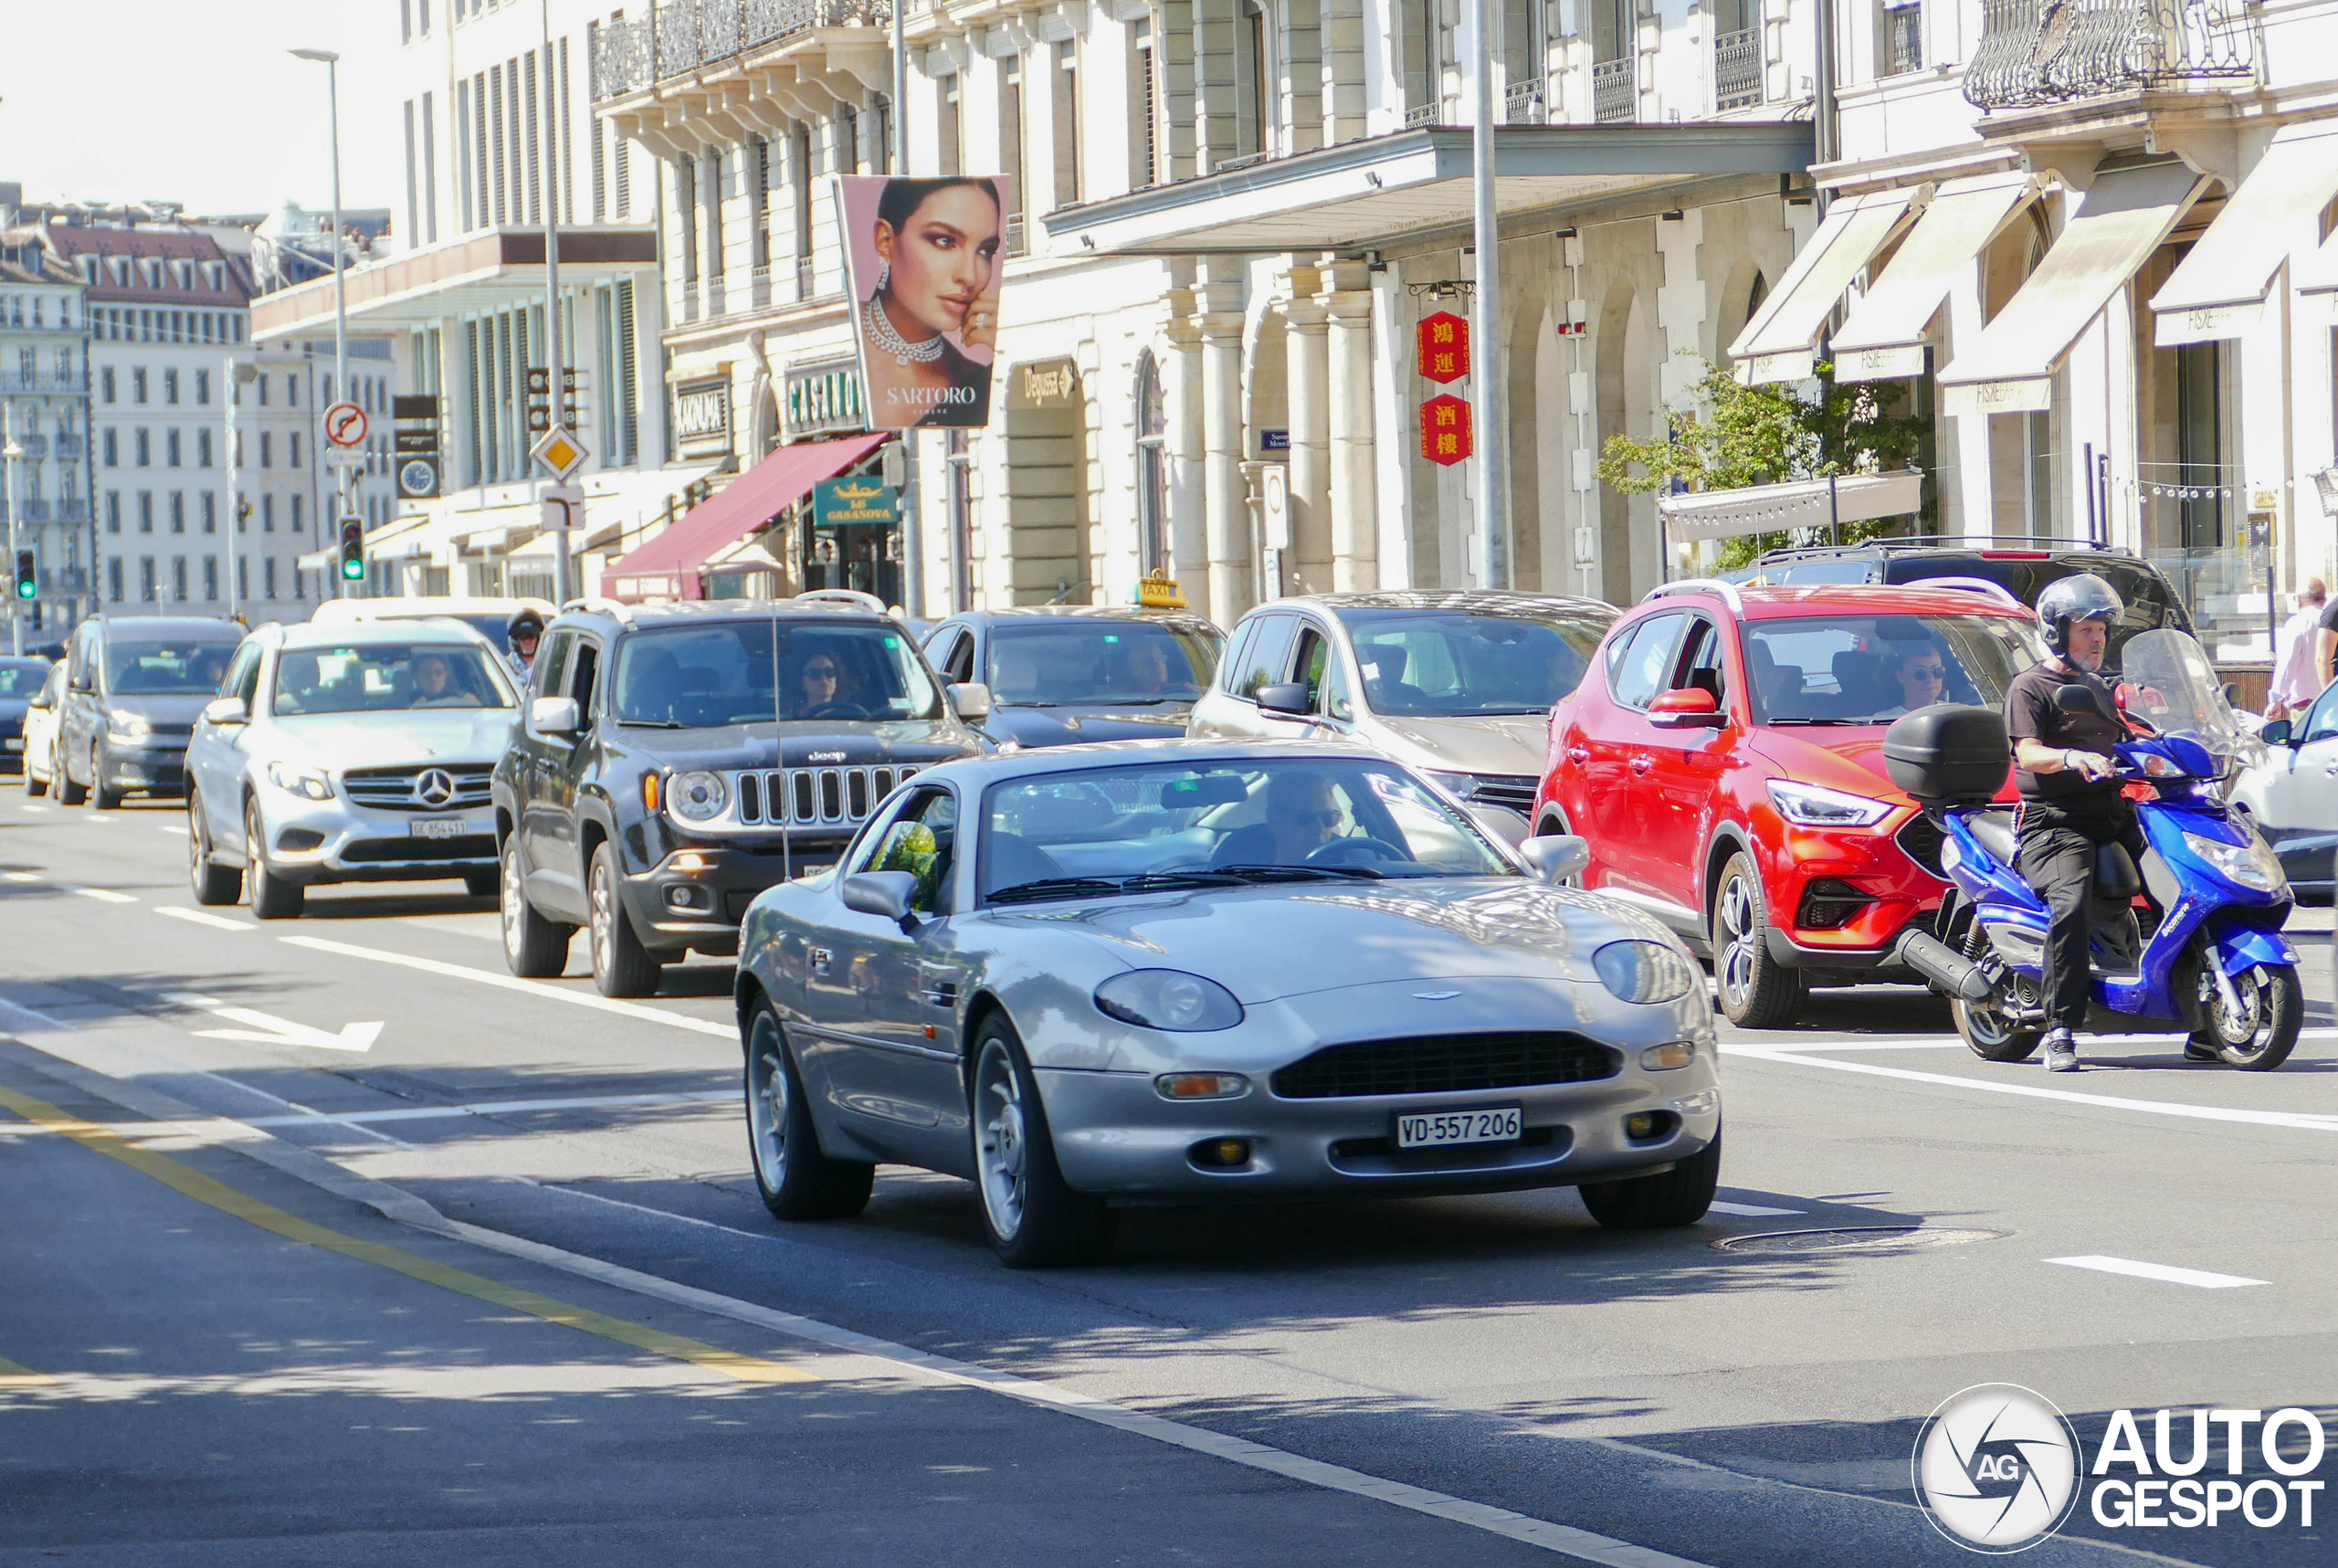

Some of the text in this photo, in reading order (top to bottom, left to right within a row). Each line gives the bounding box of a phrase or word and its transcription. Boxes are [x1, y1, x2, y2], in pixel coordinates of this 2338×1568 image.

[886, 385, 977, 405] SARTORO
[850, 499, 867, 510] LE
[827, 508, 891, 521] CASANOVA
[1142, 584, 1168, 596] TAXI
[808, 750, 848, 763] Jeep
[1478, 1111, 1519, 1137] 206
